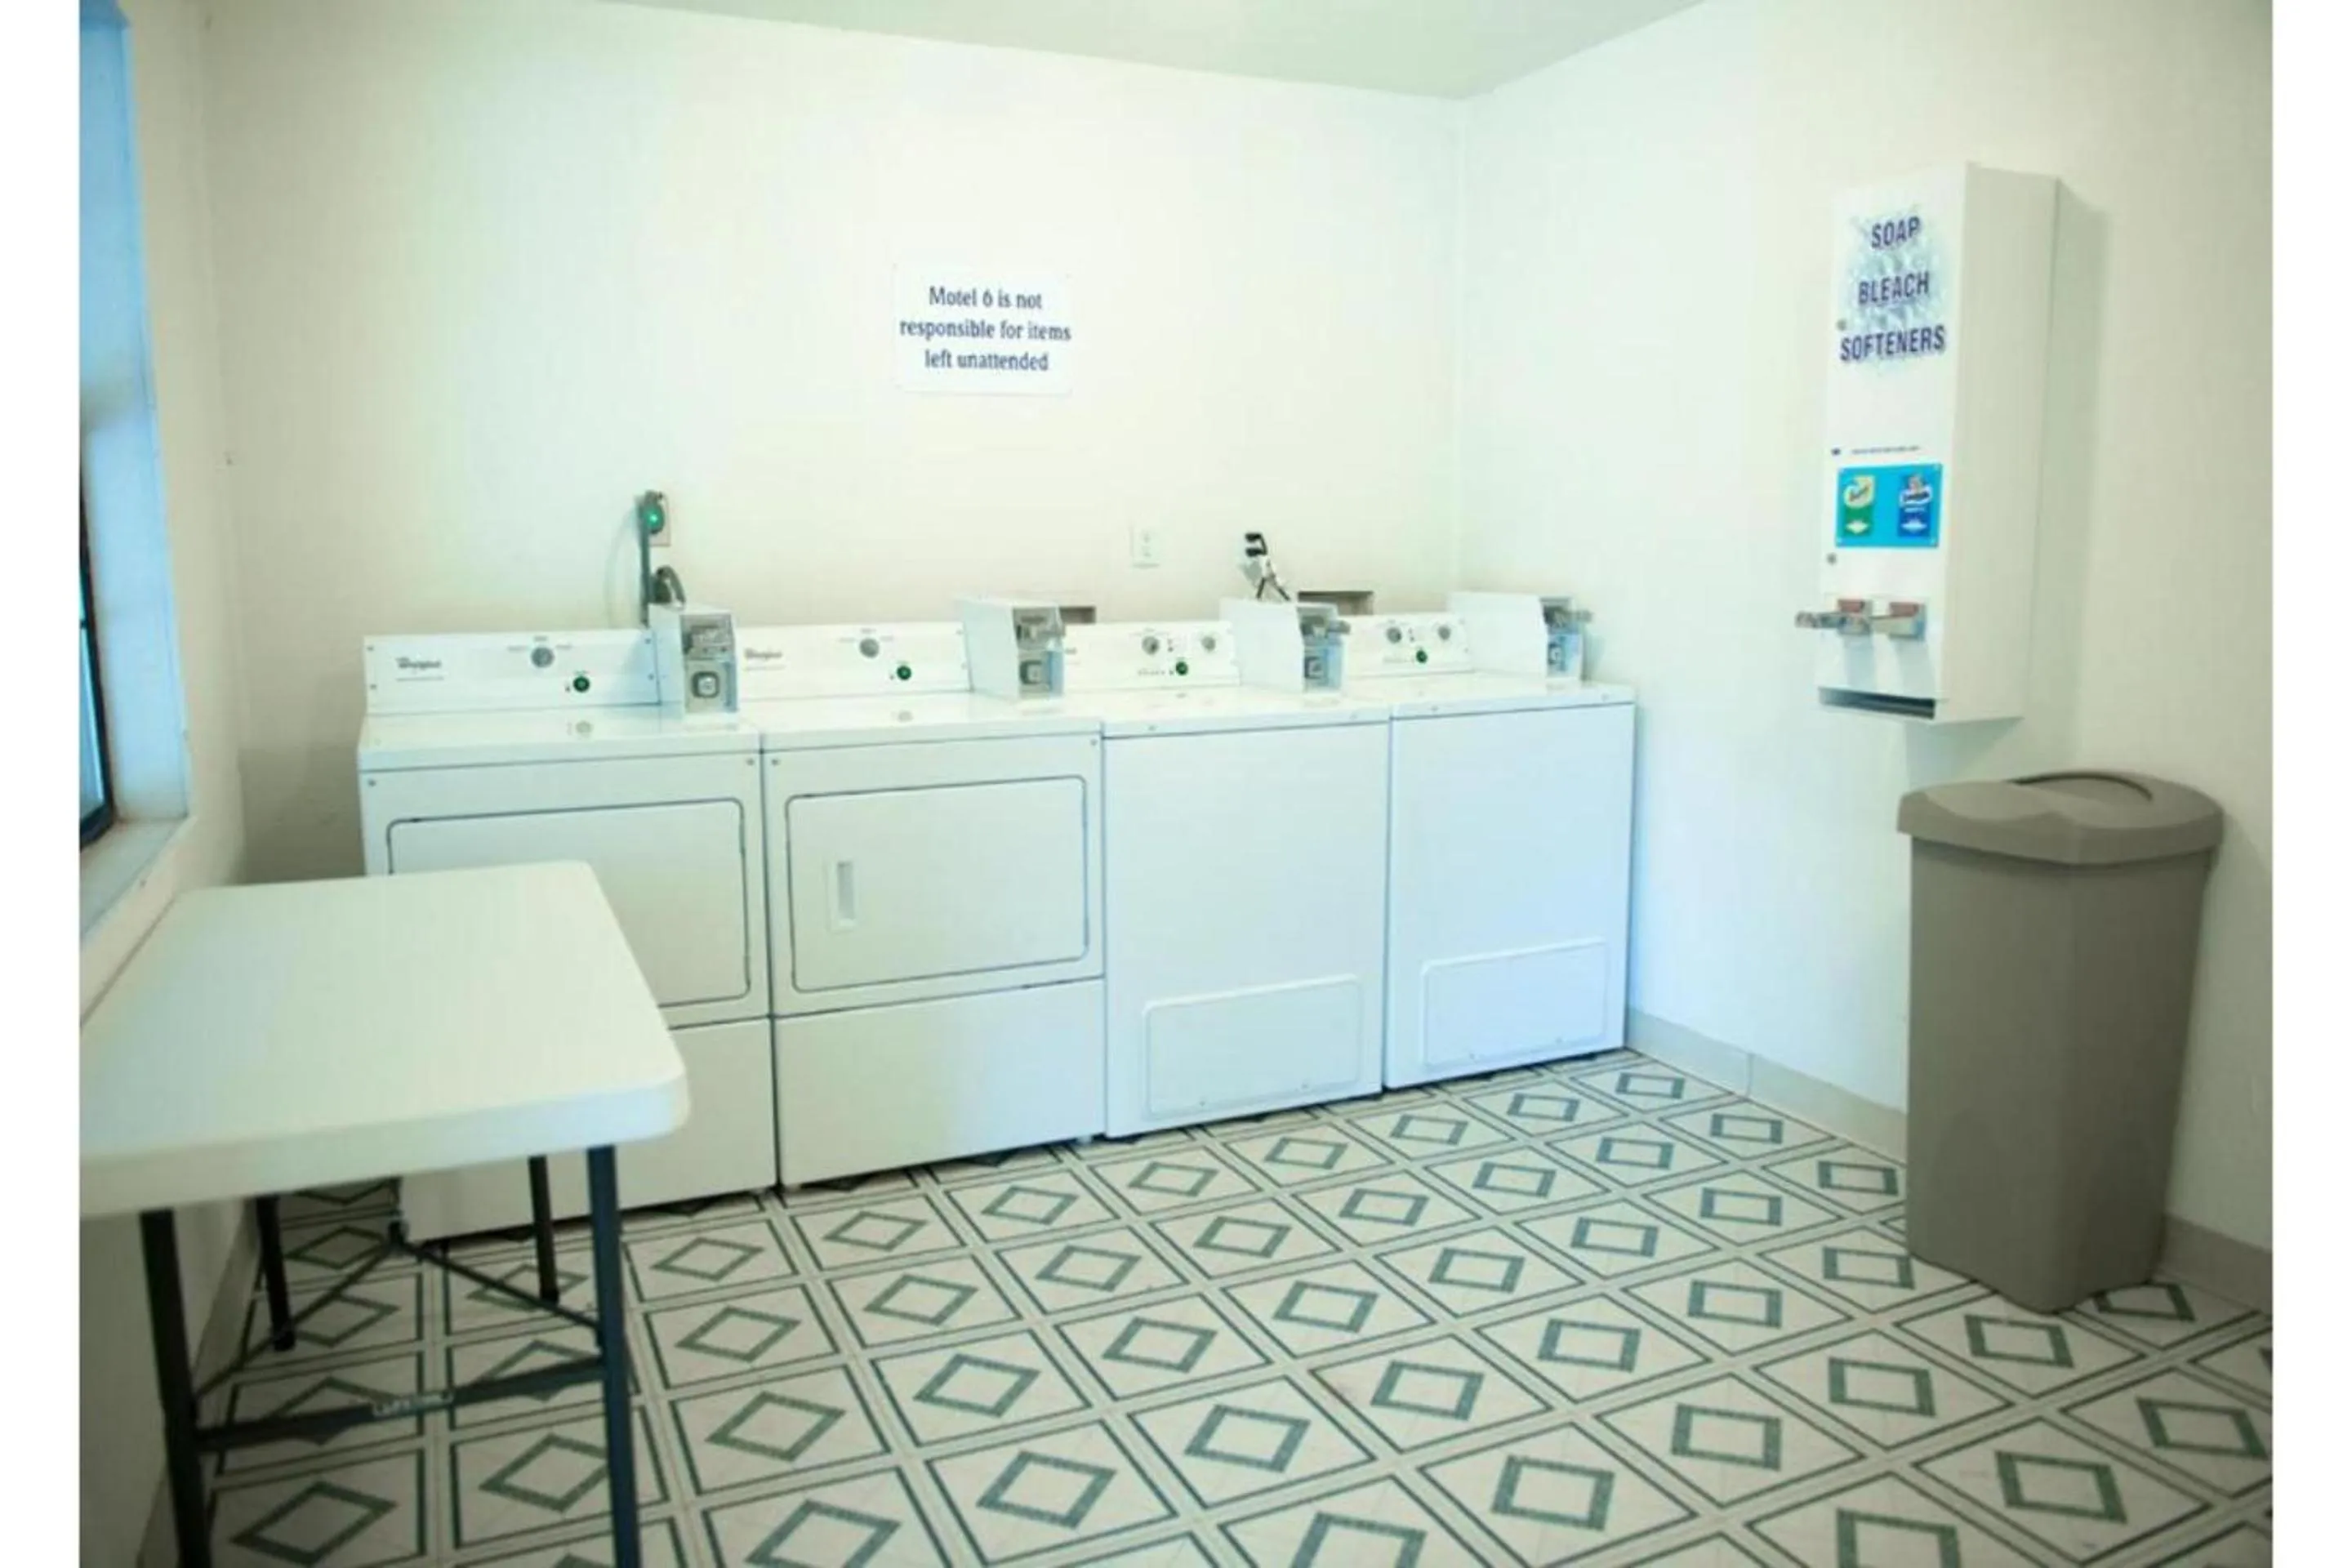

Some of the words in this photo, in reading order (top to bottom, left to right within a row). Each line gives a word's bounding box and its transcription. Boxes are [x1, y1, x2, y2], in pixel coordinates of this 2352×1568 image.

[1871, 216, 1920, 249] SOAP
[929, 286, 978, 307] Motel
[982, 288, 994, 309] 6
[998, 289, 1012, 309] is
[1017, 292, 1043, 310] not
[1859, 270, 1930, 305] BLEACH
[899, 318, 996, 341] responsible
[1000, 319, 1024, 340] for
[1027, 321, 1072, 341] items
[1840, 324, 1946, 362] SOFTENERS
[924, 348, 952, 368] left
[956, 351, 1049, 371] unattended
